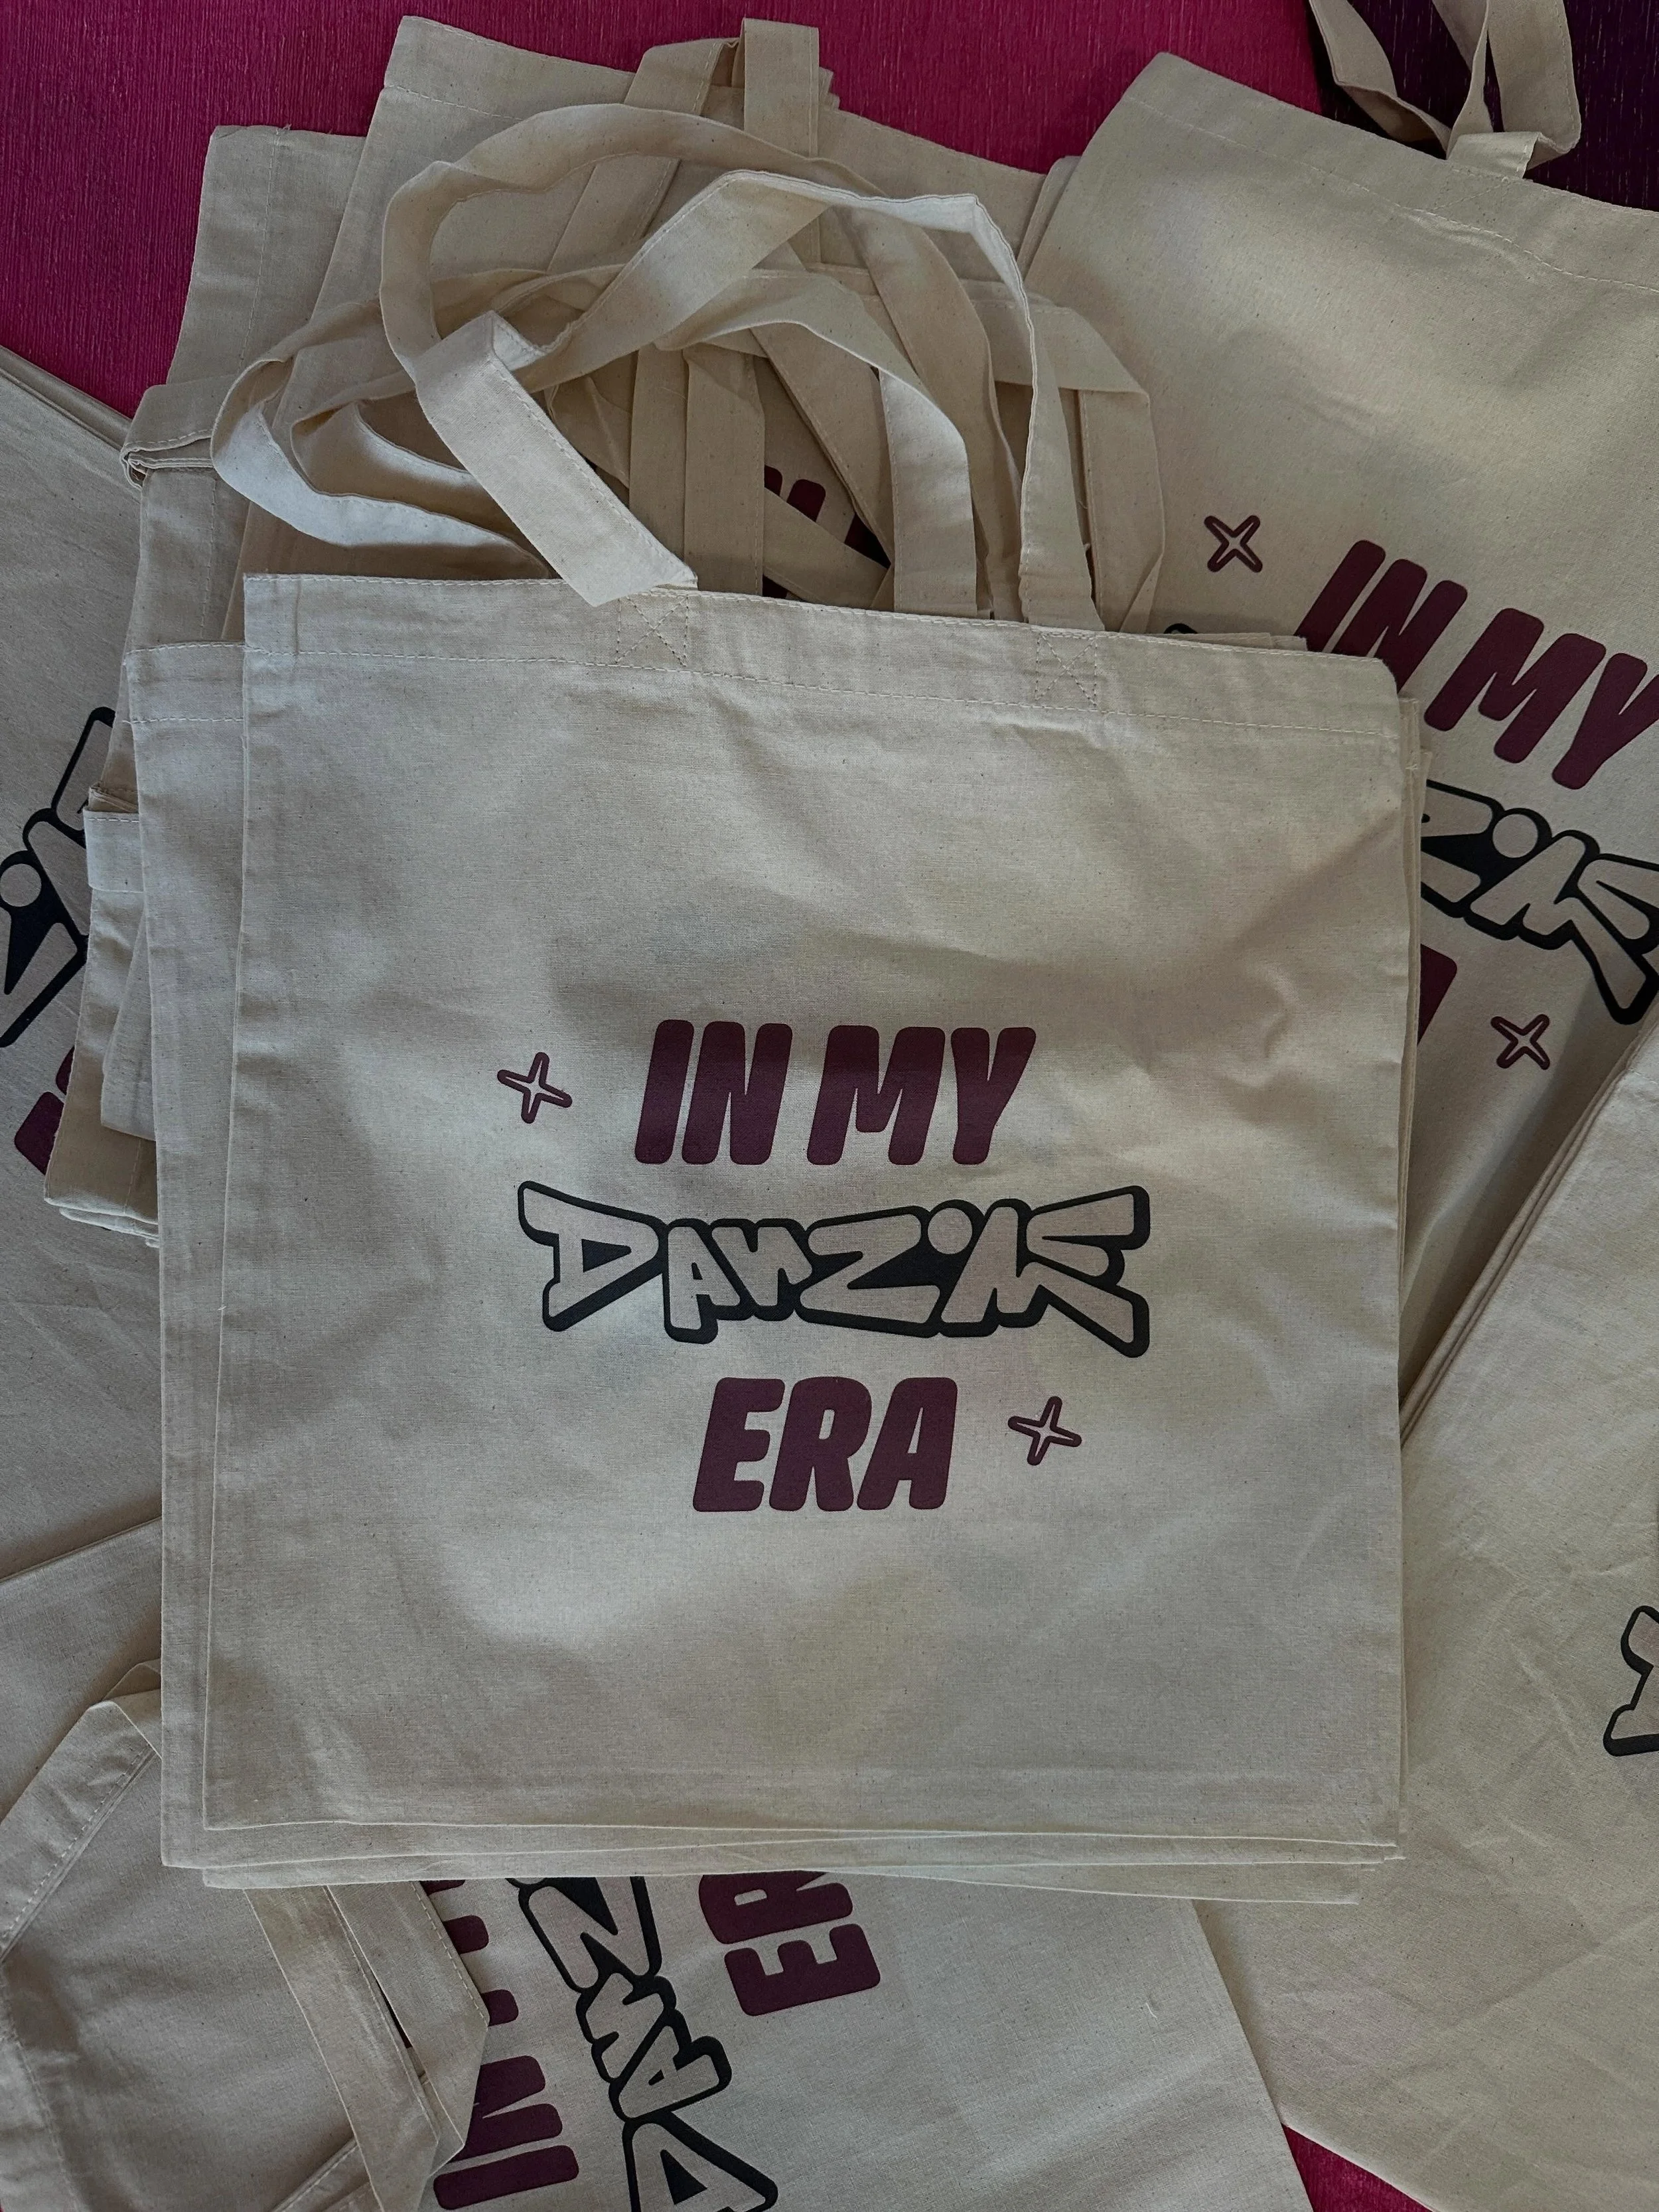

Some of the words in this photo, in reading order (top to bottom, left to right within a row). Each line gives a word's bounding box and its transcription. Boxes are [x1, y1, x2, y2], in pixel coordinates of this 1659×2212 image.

[1294, 540, 1468, 693] IN
[1425, 608, 1659, 790] MY
[634, 1019, 792, 1164] IN
[806, 1025, 1037, 1165] MY
[693, 1376, 958, 1512] ERA
[699, 1870, 881, 2016] ER
